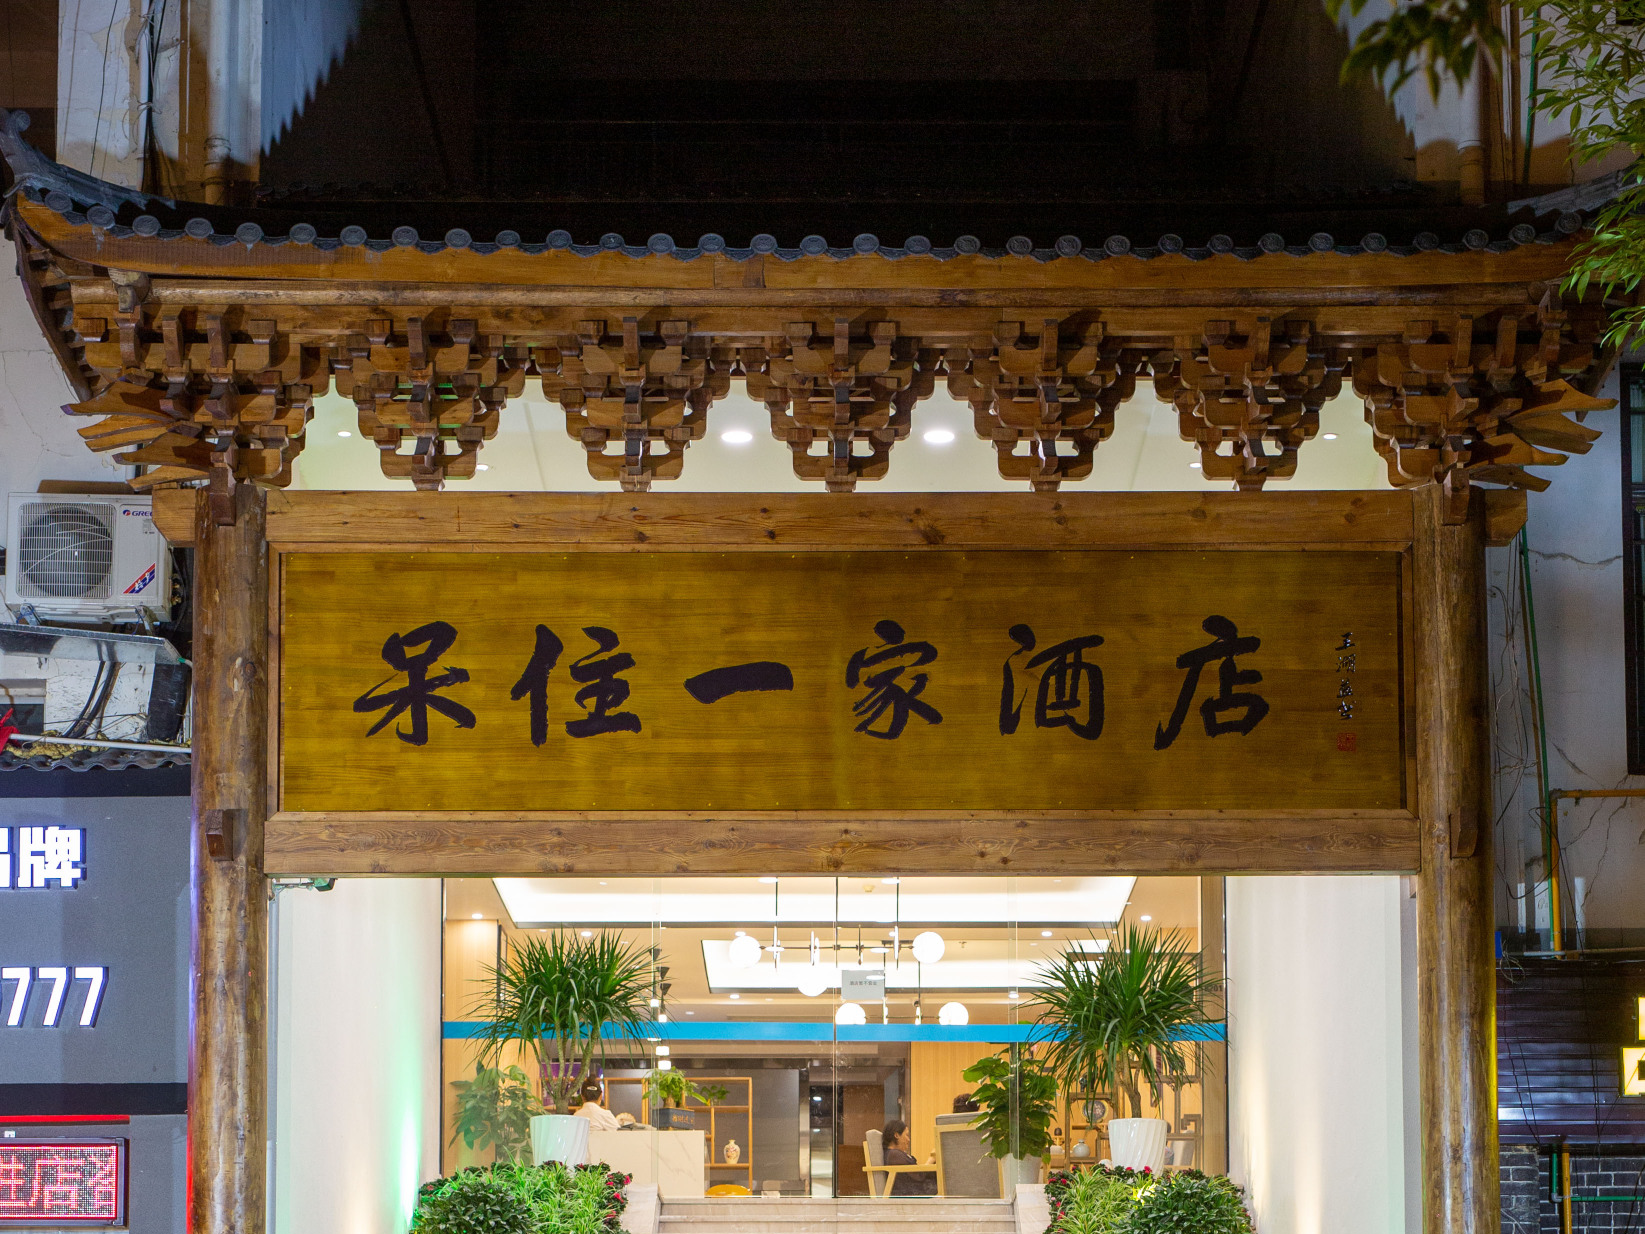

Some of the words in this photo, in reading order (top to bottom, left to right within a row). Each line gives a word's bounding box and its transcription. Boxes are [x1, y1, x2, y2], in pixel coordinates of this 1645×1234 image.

[353, 614, 1269, 751] 呆住一家酒店
